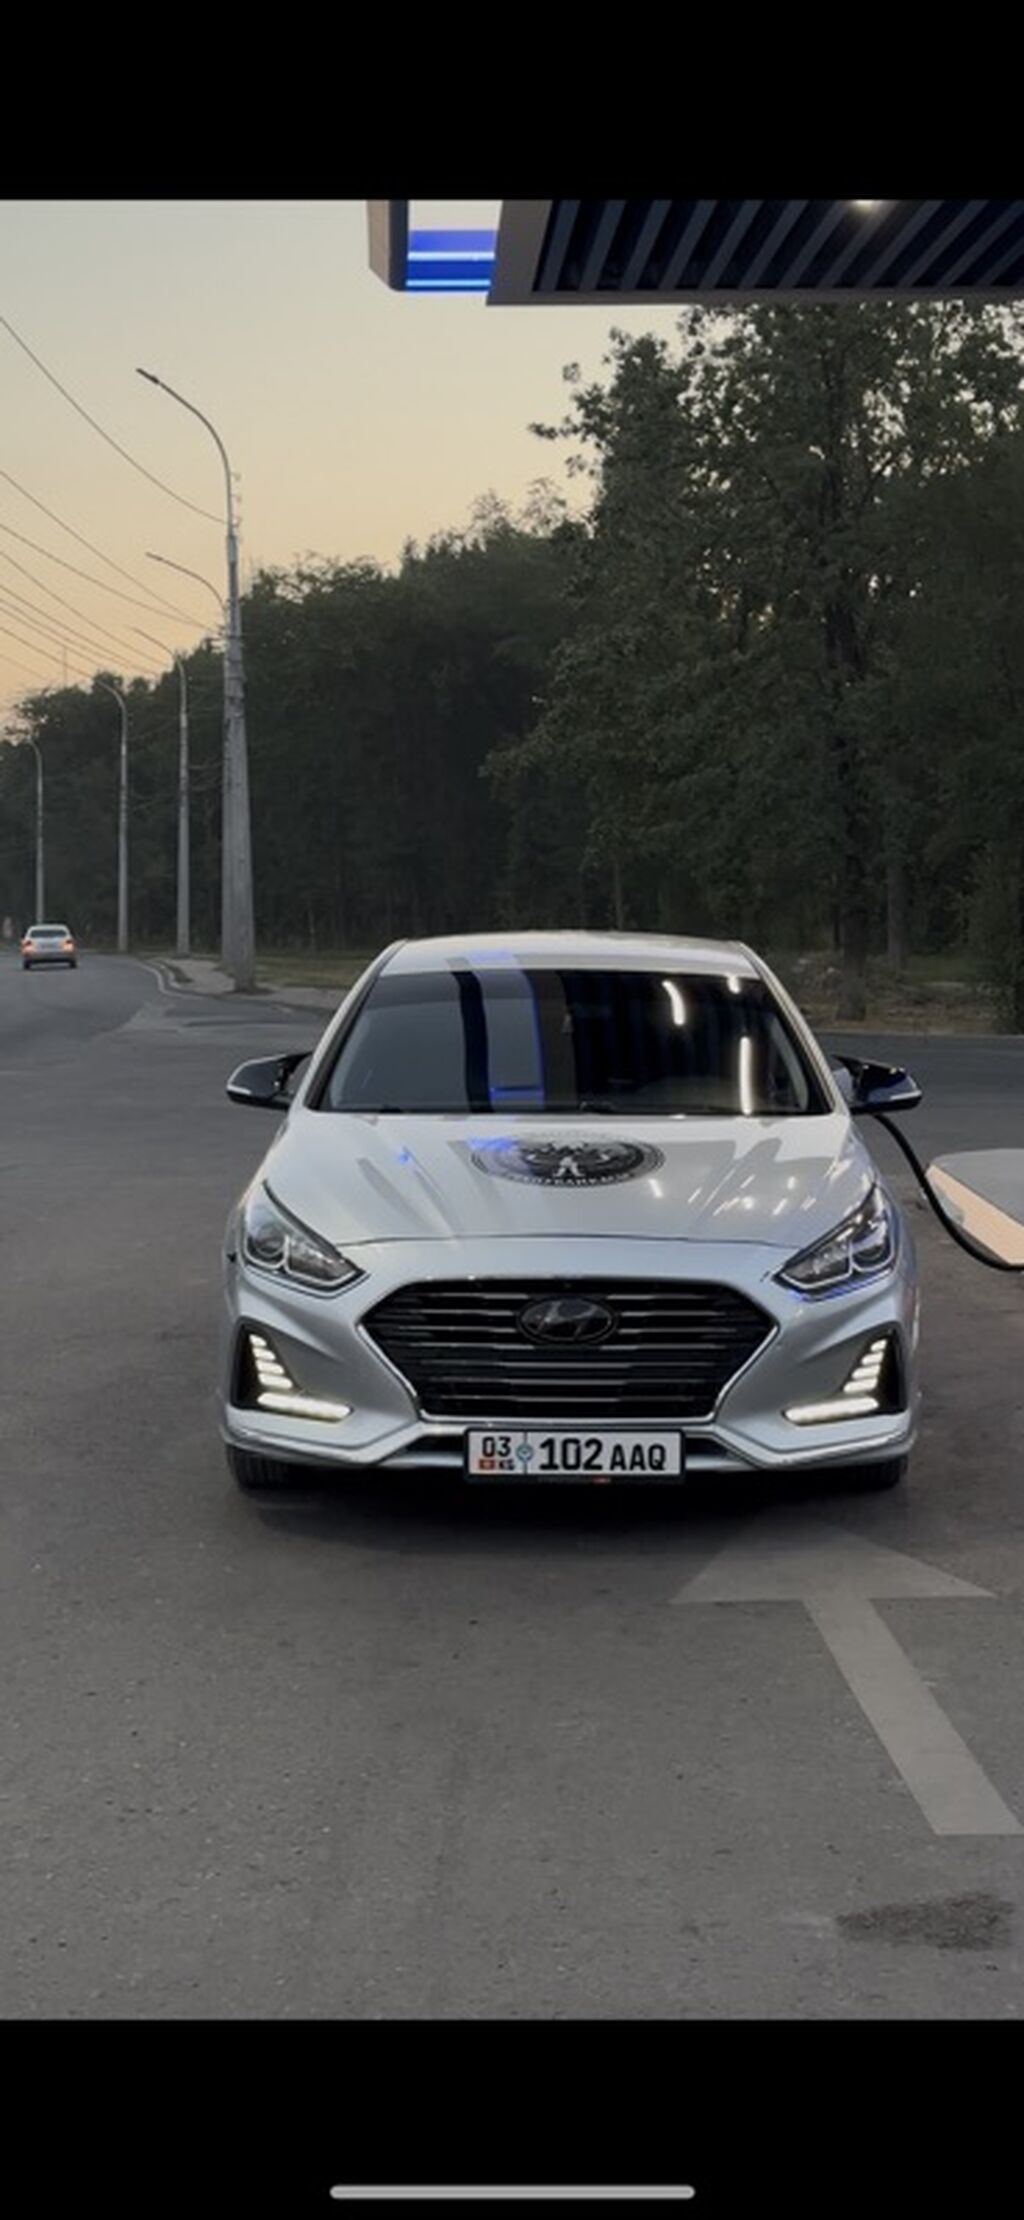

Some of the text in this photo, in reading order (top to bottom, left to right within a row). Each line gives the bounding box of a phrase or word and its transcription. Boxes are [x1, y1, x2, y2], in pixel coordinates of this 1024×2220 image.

[482, 1436, 511, 1457] 03
[538, 1437, 666, 1471] 102 AAQ
